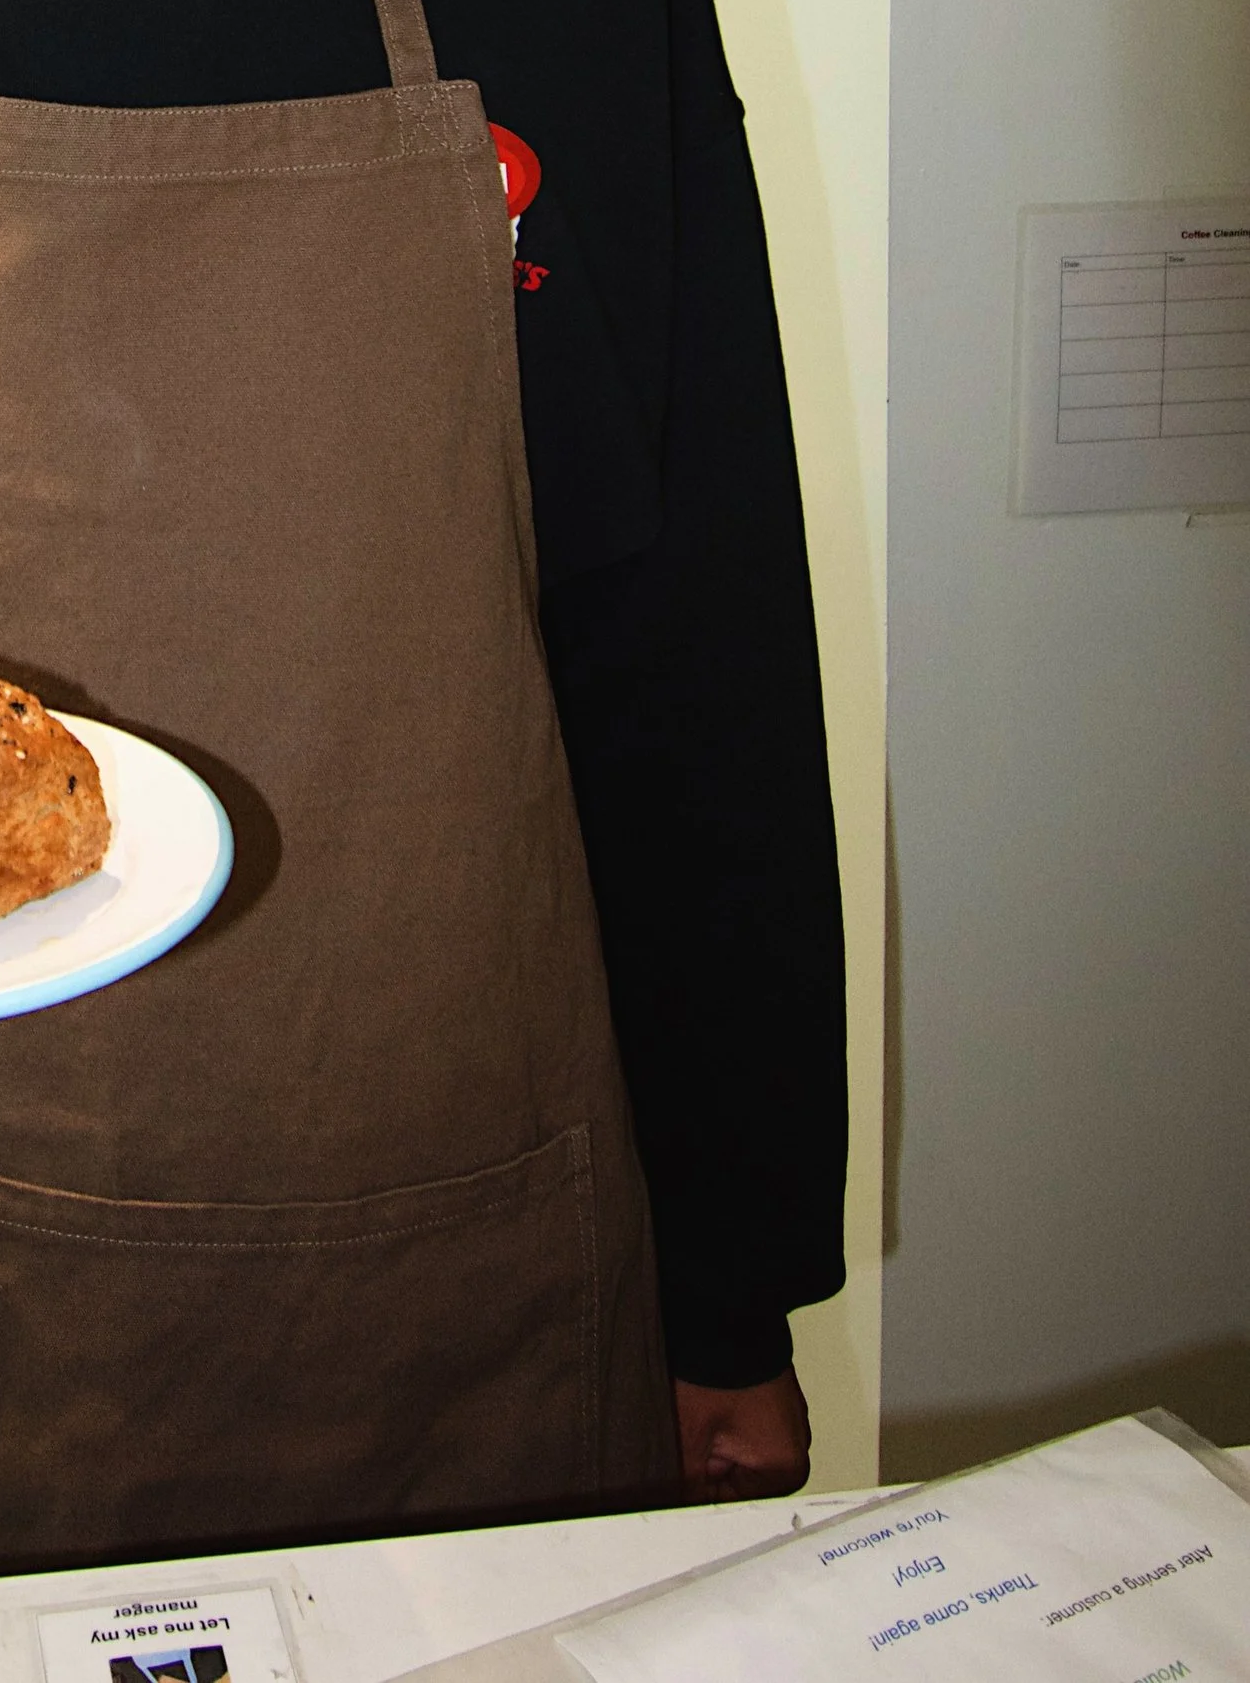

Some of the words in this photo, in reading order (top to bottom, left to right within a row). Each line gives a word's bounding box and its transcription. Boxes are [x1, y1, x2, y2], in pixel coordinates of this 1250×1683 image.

[1181, 229, 1210, 240] Coffee
[896, 1509, 949, 1533] You're
[817, 1527, 895, 1566] welcome!
[1177, 1544, 1214, 1570] After
[892, 1555, 946, 1587] Enjoy!
[1122, 1562, 1178, 1590] serving
[969, 1573, 1039, 1605] Thanks,
[1112, 1584, 1125, 1595] a
[113, 1599, 198, 1618] manager
[923, 1599, 970, 1626] come
[1040, 1590, 1112, 1627] customer:
[125, 1625, 158, 1641] ask
[164, 1621, 194, 1633] me
[200, 1617, 230, 1631] Let
[869, 1619, 921, 1652] again!
[91, 1629, 120, 1644] my
[1133, 1660, 1192, 1683] Wou
